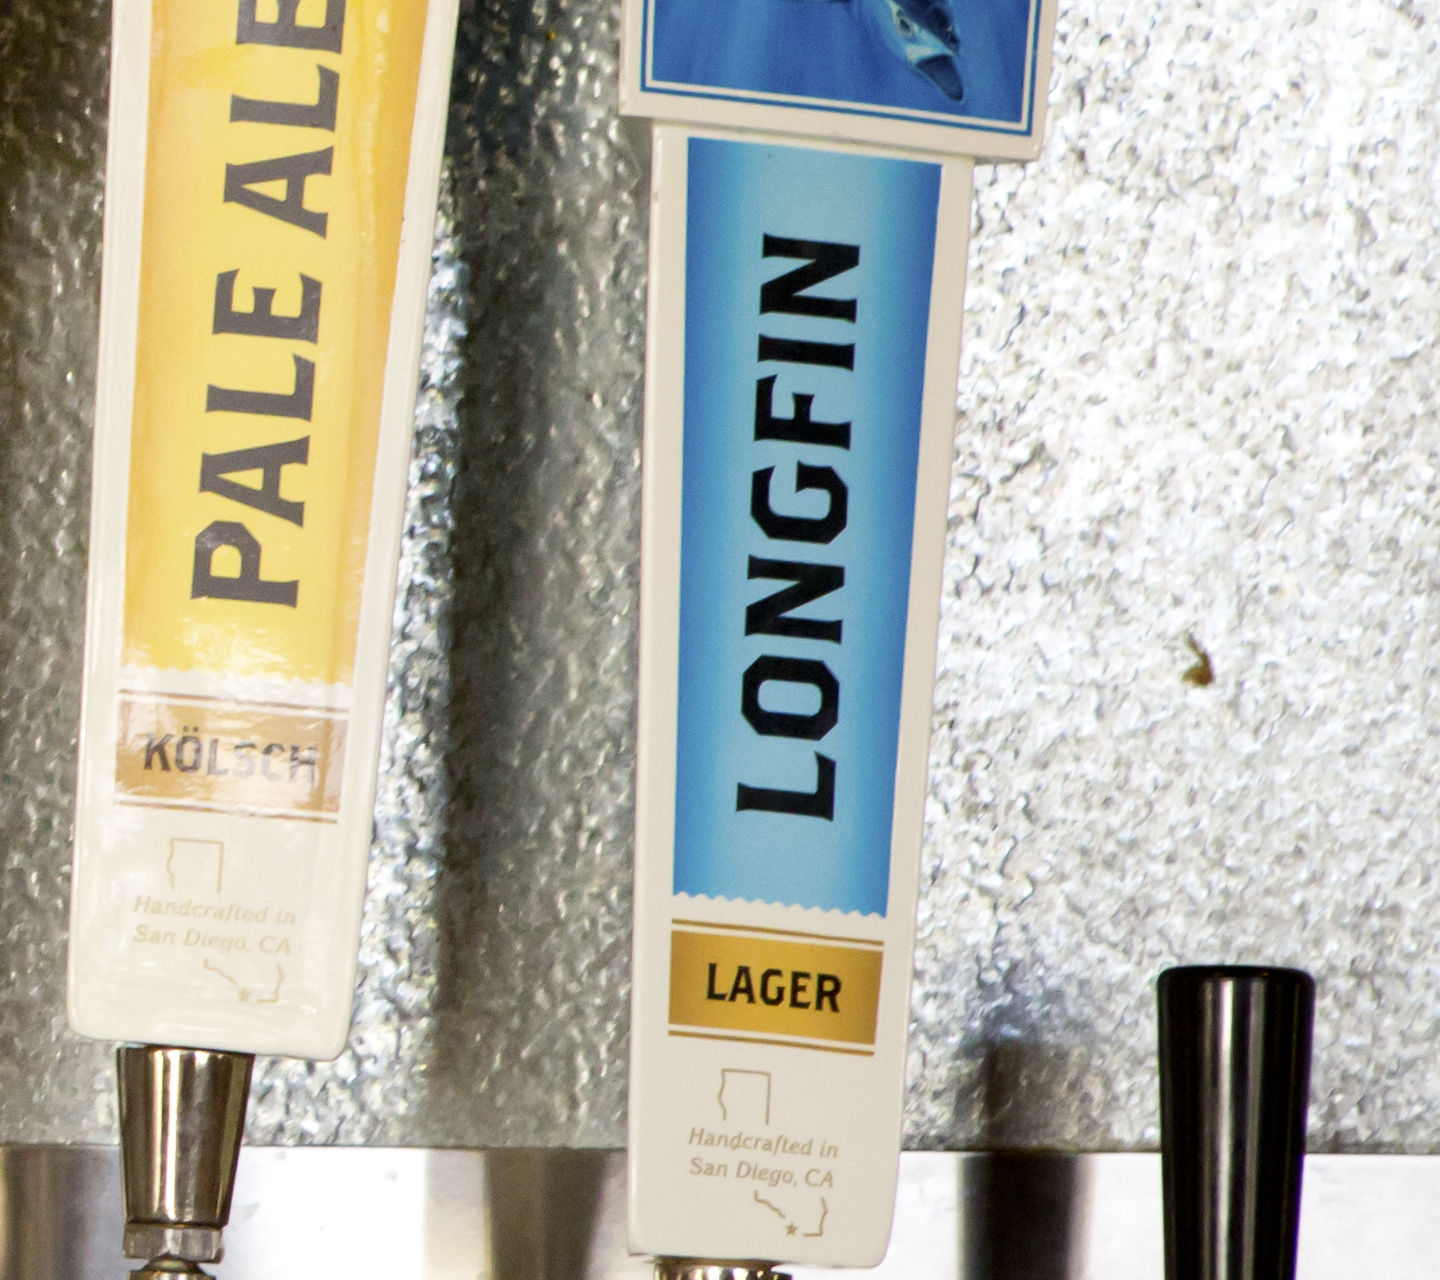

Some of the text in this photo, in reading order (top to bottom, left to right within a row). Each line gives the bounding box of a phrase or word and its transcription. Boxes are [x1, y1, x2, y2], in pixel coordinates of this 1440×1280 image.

[190, 267, 324, 610] PALE
[735, 232, 863, 824] LONGFIN
[144, 726, 317, 784] KÖLSCH
[705, 963, 843, 1013] LAGER
[689, 1127, 838, 1158] Handcrafted in
[690, 1157, 833, 1188] San Diego, CA
